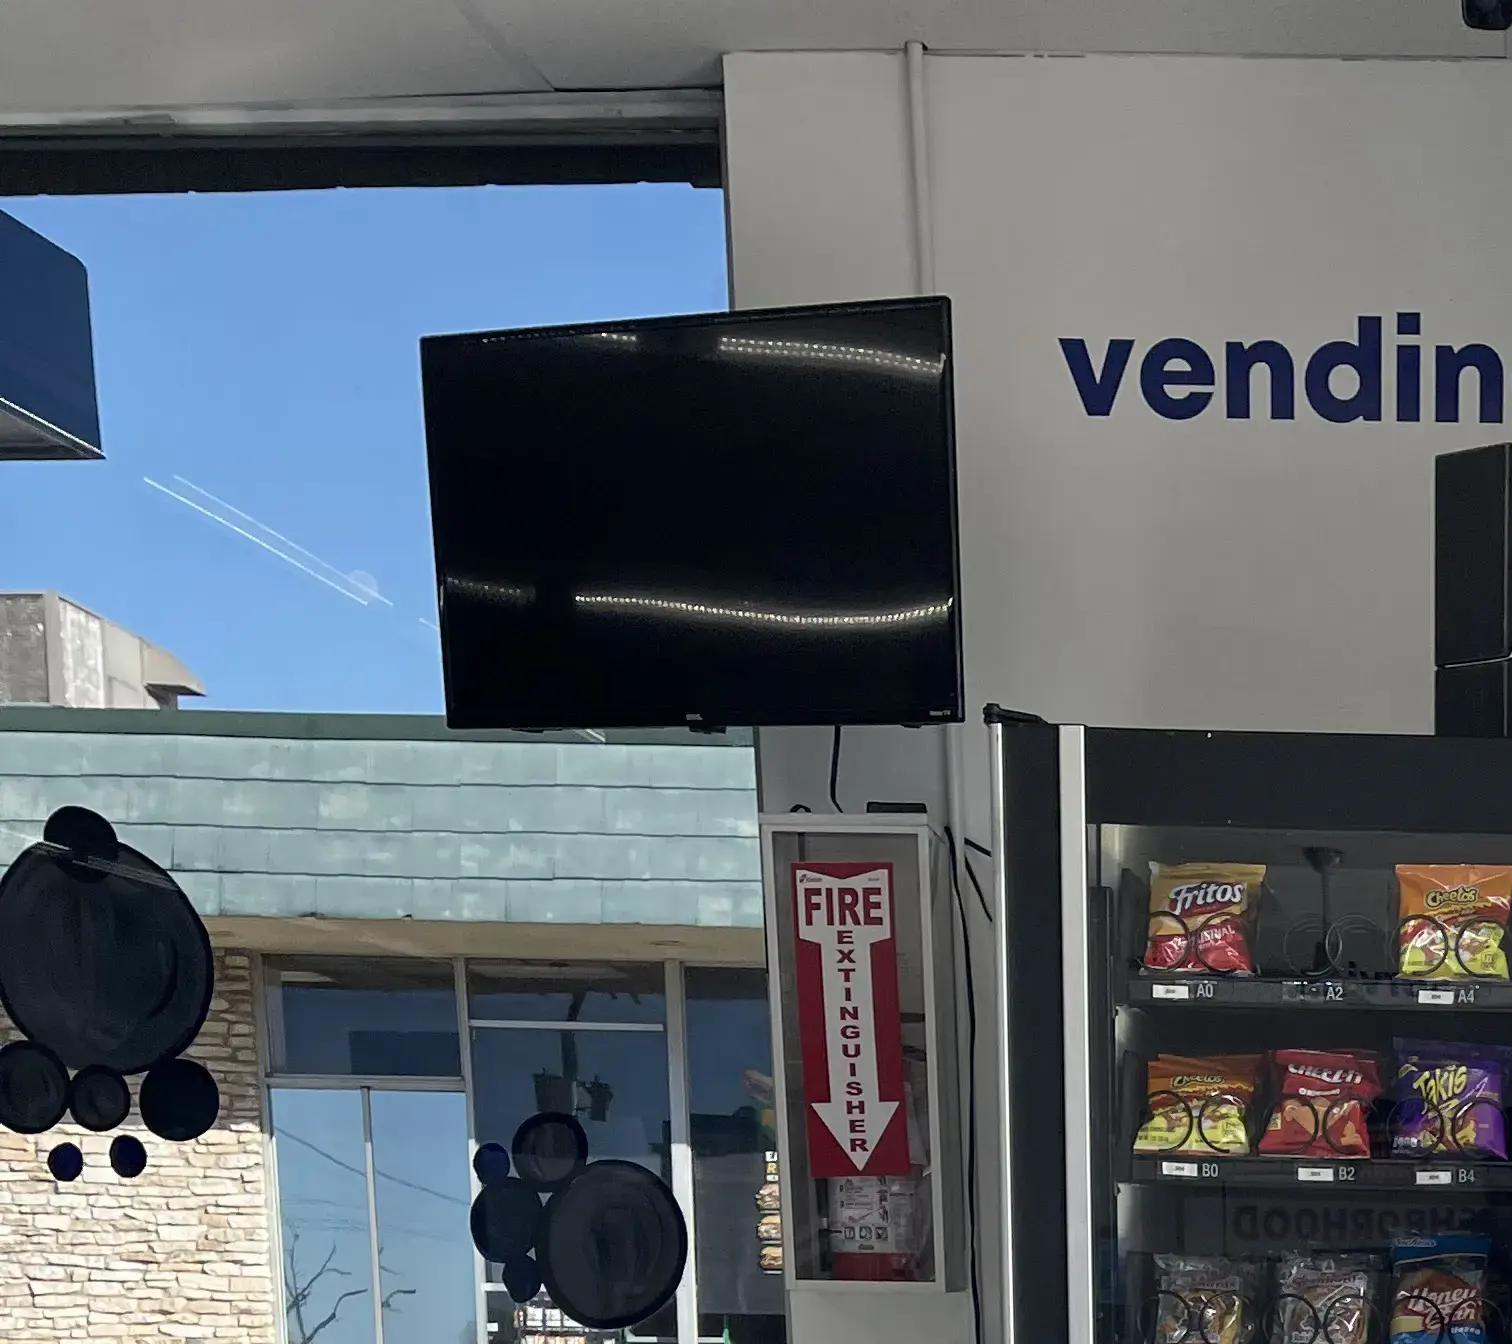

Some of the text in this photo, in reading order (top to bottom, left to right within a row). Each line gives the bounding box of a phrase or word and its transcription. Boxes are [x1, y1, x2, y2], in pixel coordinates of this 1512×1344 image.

[1169, 882, 1245, 915] Fritos
[1426, 886, 1479, 907] Cheetos
[804, 887, 883, 927] FIRE
[1196, 983, 1213, 998] A0
[1326, 985, 1343, 1000] A2
[1457, 990, 1475, 1004] A4
[837, 930, 869, 1153] EXTINGUISHER
[1202, 1164, 1218, 1178] B0
[1338, 1167, 1355, 1181] B2
[1458, 1169, 1475, 1183] B4
